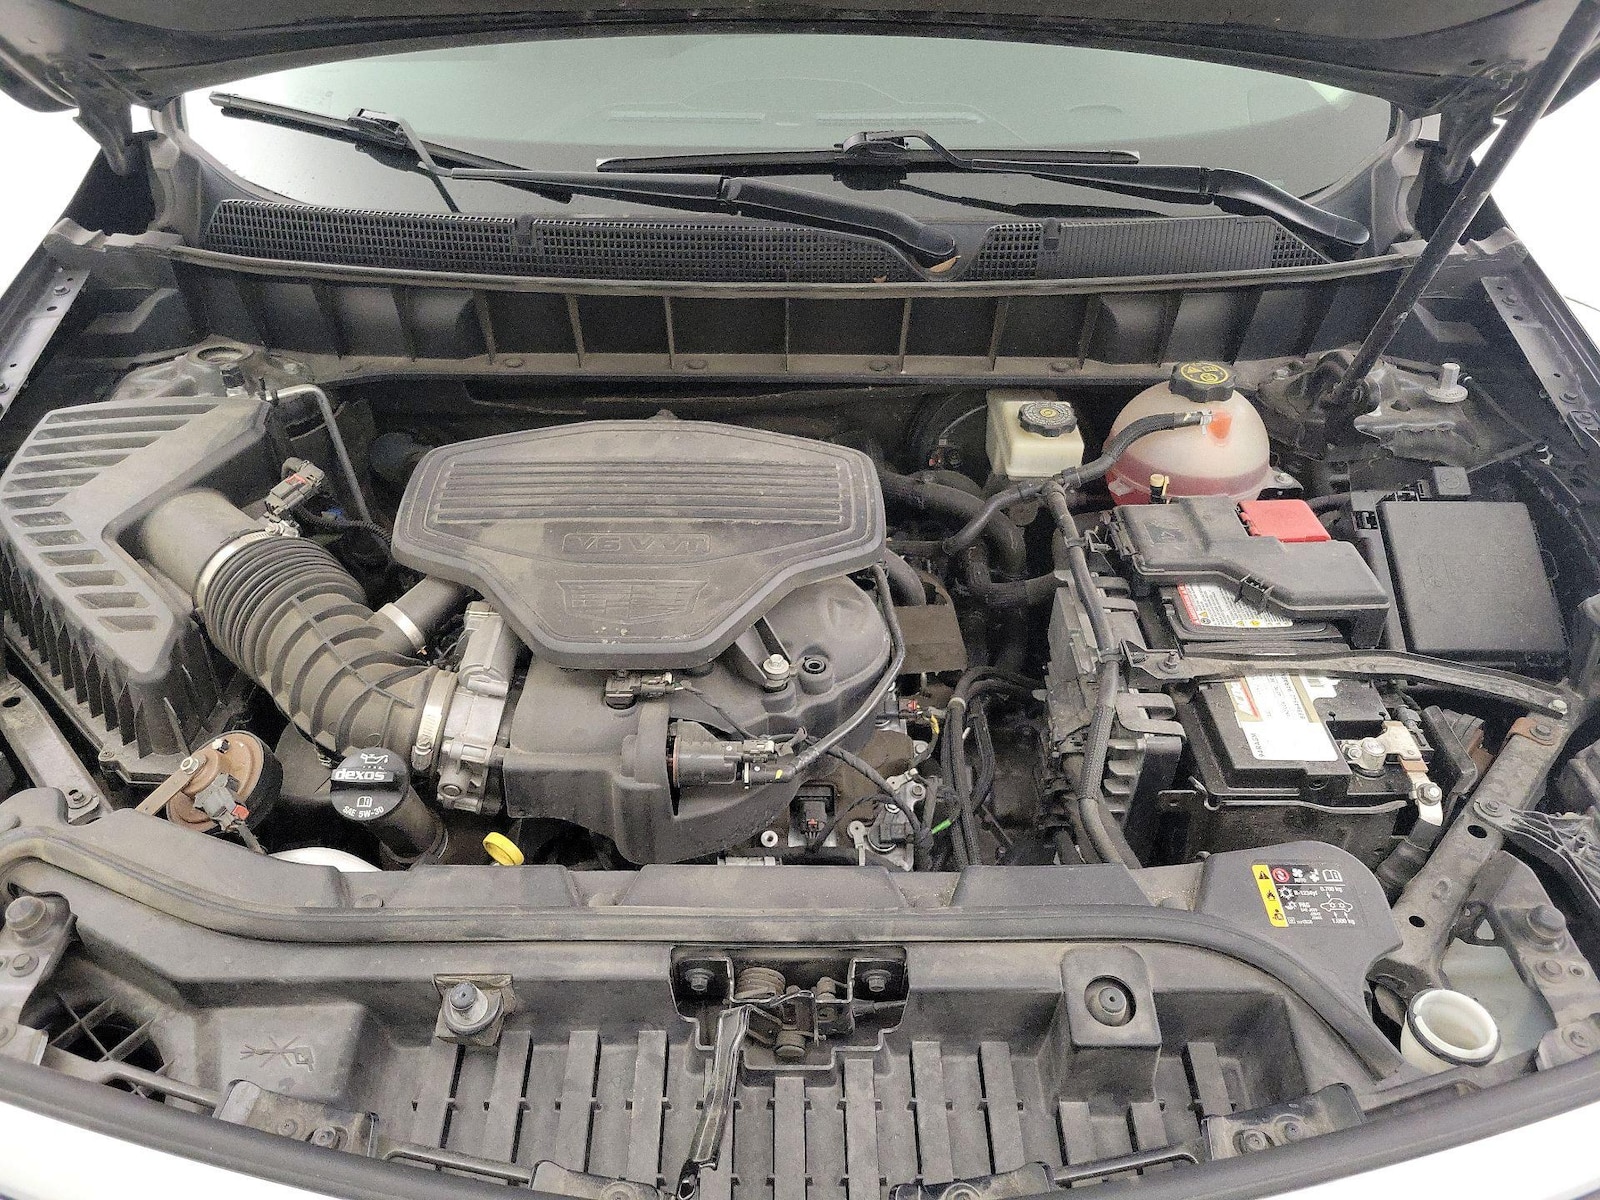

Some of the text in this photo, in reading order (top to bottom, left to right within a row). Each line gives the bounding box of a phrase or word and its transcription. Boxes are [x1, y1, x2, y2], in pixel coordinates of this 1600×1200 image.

[334, 768, 387, 780] dexos
[343, 806, 385, 818] SAE 5W-30
